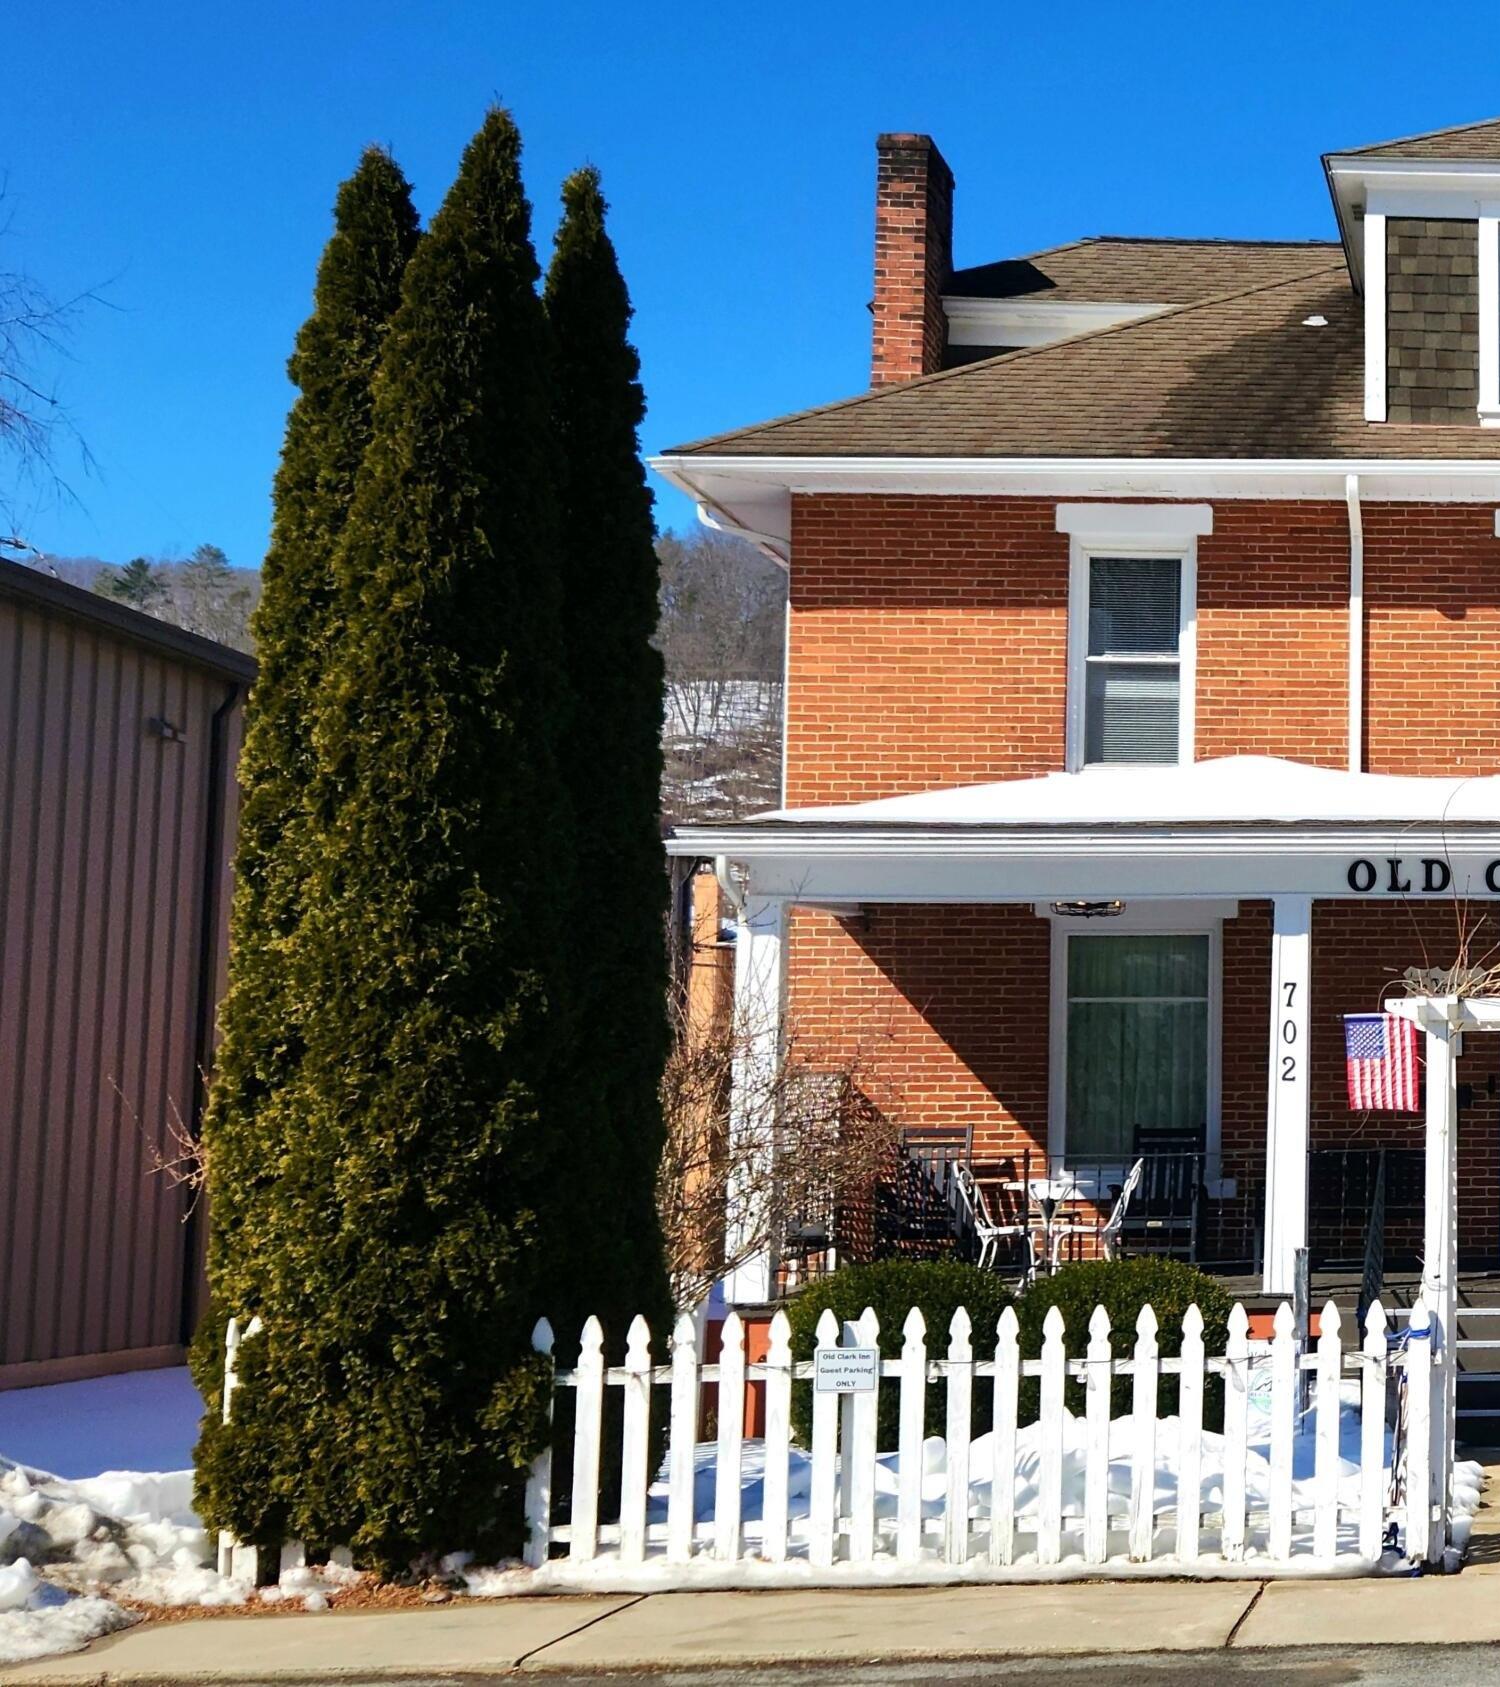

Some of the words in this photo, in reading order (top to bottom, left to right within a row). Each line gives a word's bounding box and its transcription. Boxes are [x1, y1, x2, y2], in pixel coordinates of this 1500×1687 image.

[1347, 859, 1451, 892] OLD
[1282, 982, 1297, 1082] 702
[843, 1367, 873, 1375] Parking
